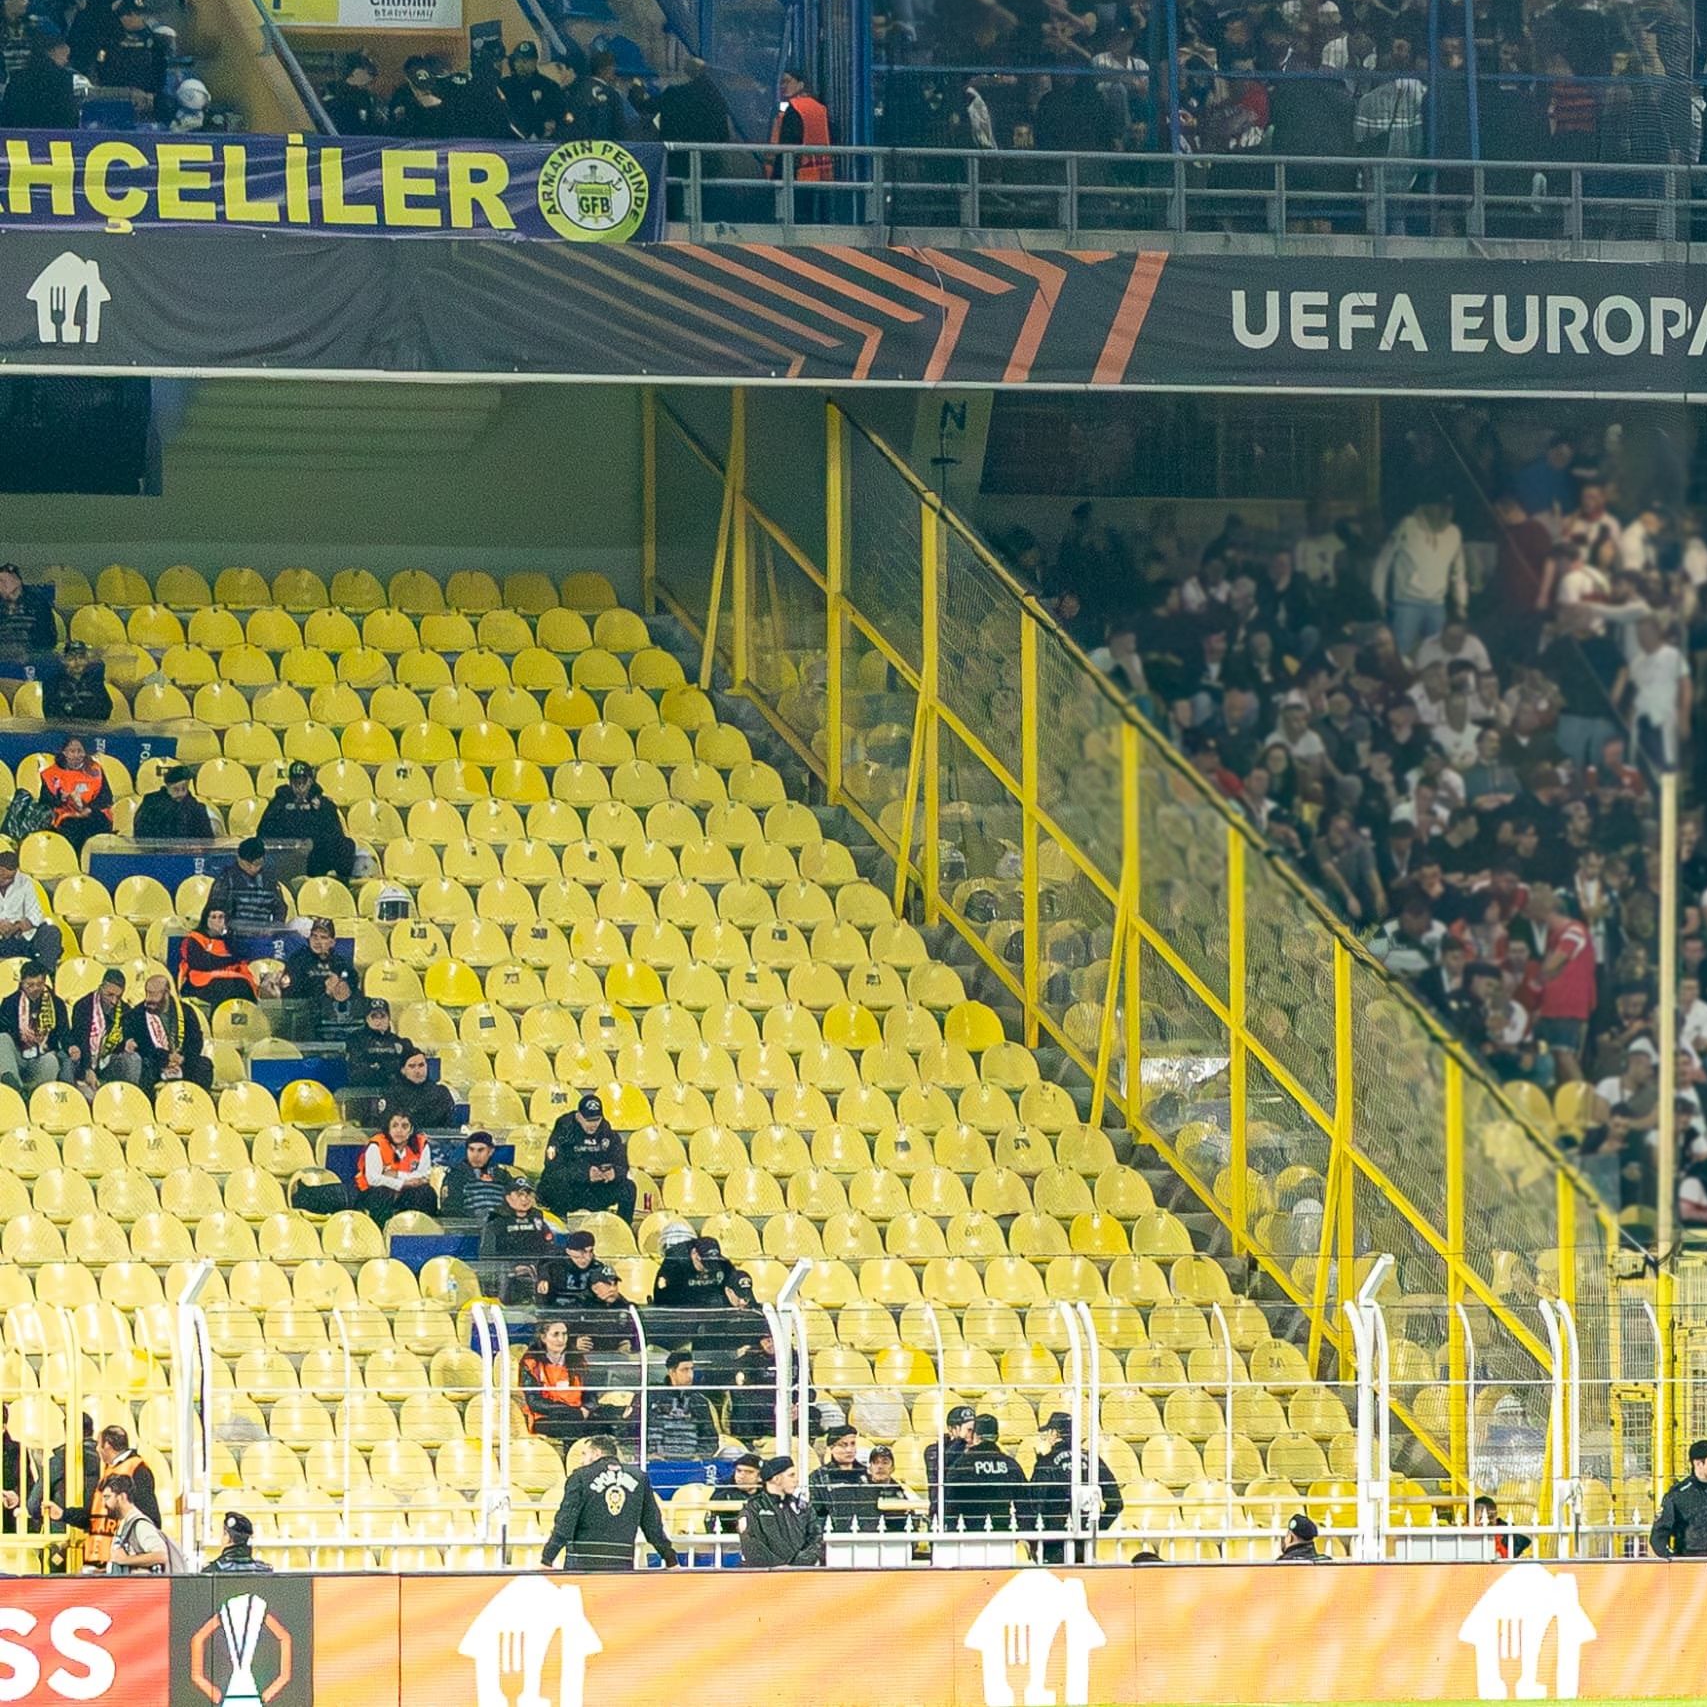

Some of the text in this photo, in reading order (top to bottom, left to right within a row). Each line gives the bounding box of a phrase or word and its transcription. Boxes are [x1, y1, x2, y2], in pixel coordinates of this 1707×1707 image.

[0, 133, 517, 234] HÇELİLER
[580, 196, 611, 214] GFB
[1231, 289, 1429, 353] UEFA
